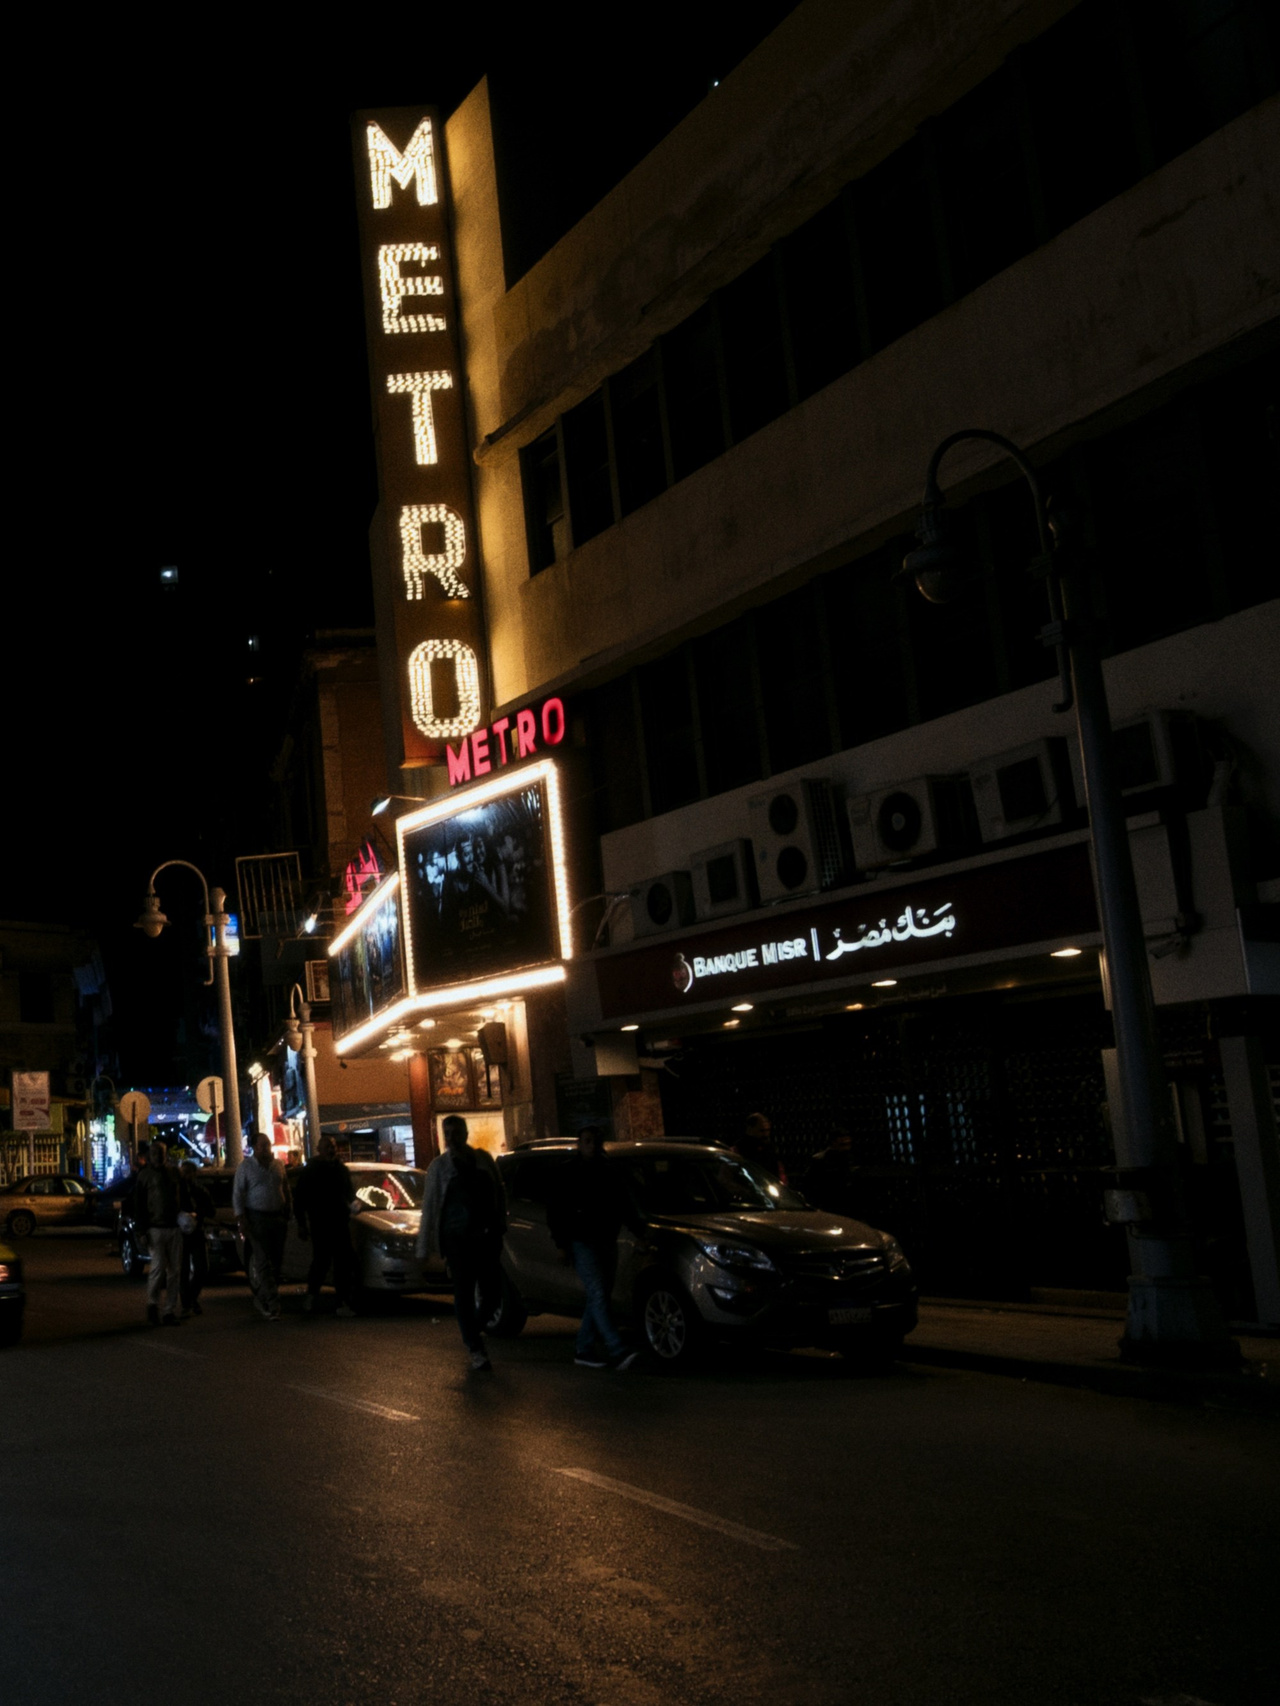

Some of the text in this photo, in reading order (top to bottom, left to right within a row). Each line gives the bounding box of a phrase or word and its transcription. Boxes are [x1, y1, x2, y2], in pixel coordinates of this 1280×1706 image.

[366, 116, 482, 739] METRO
[445, 696, 566, 787] METRO
[693, 937, 808, 978] BANQUE MISR
